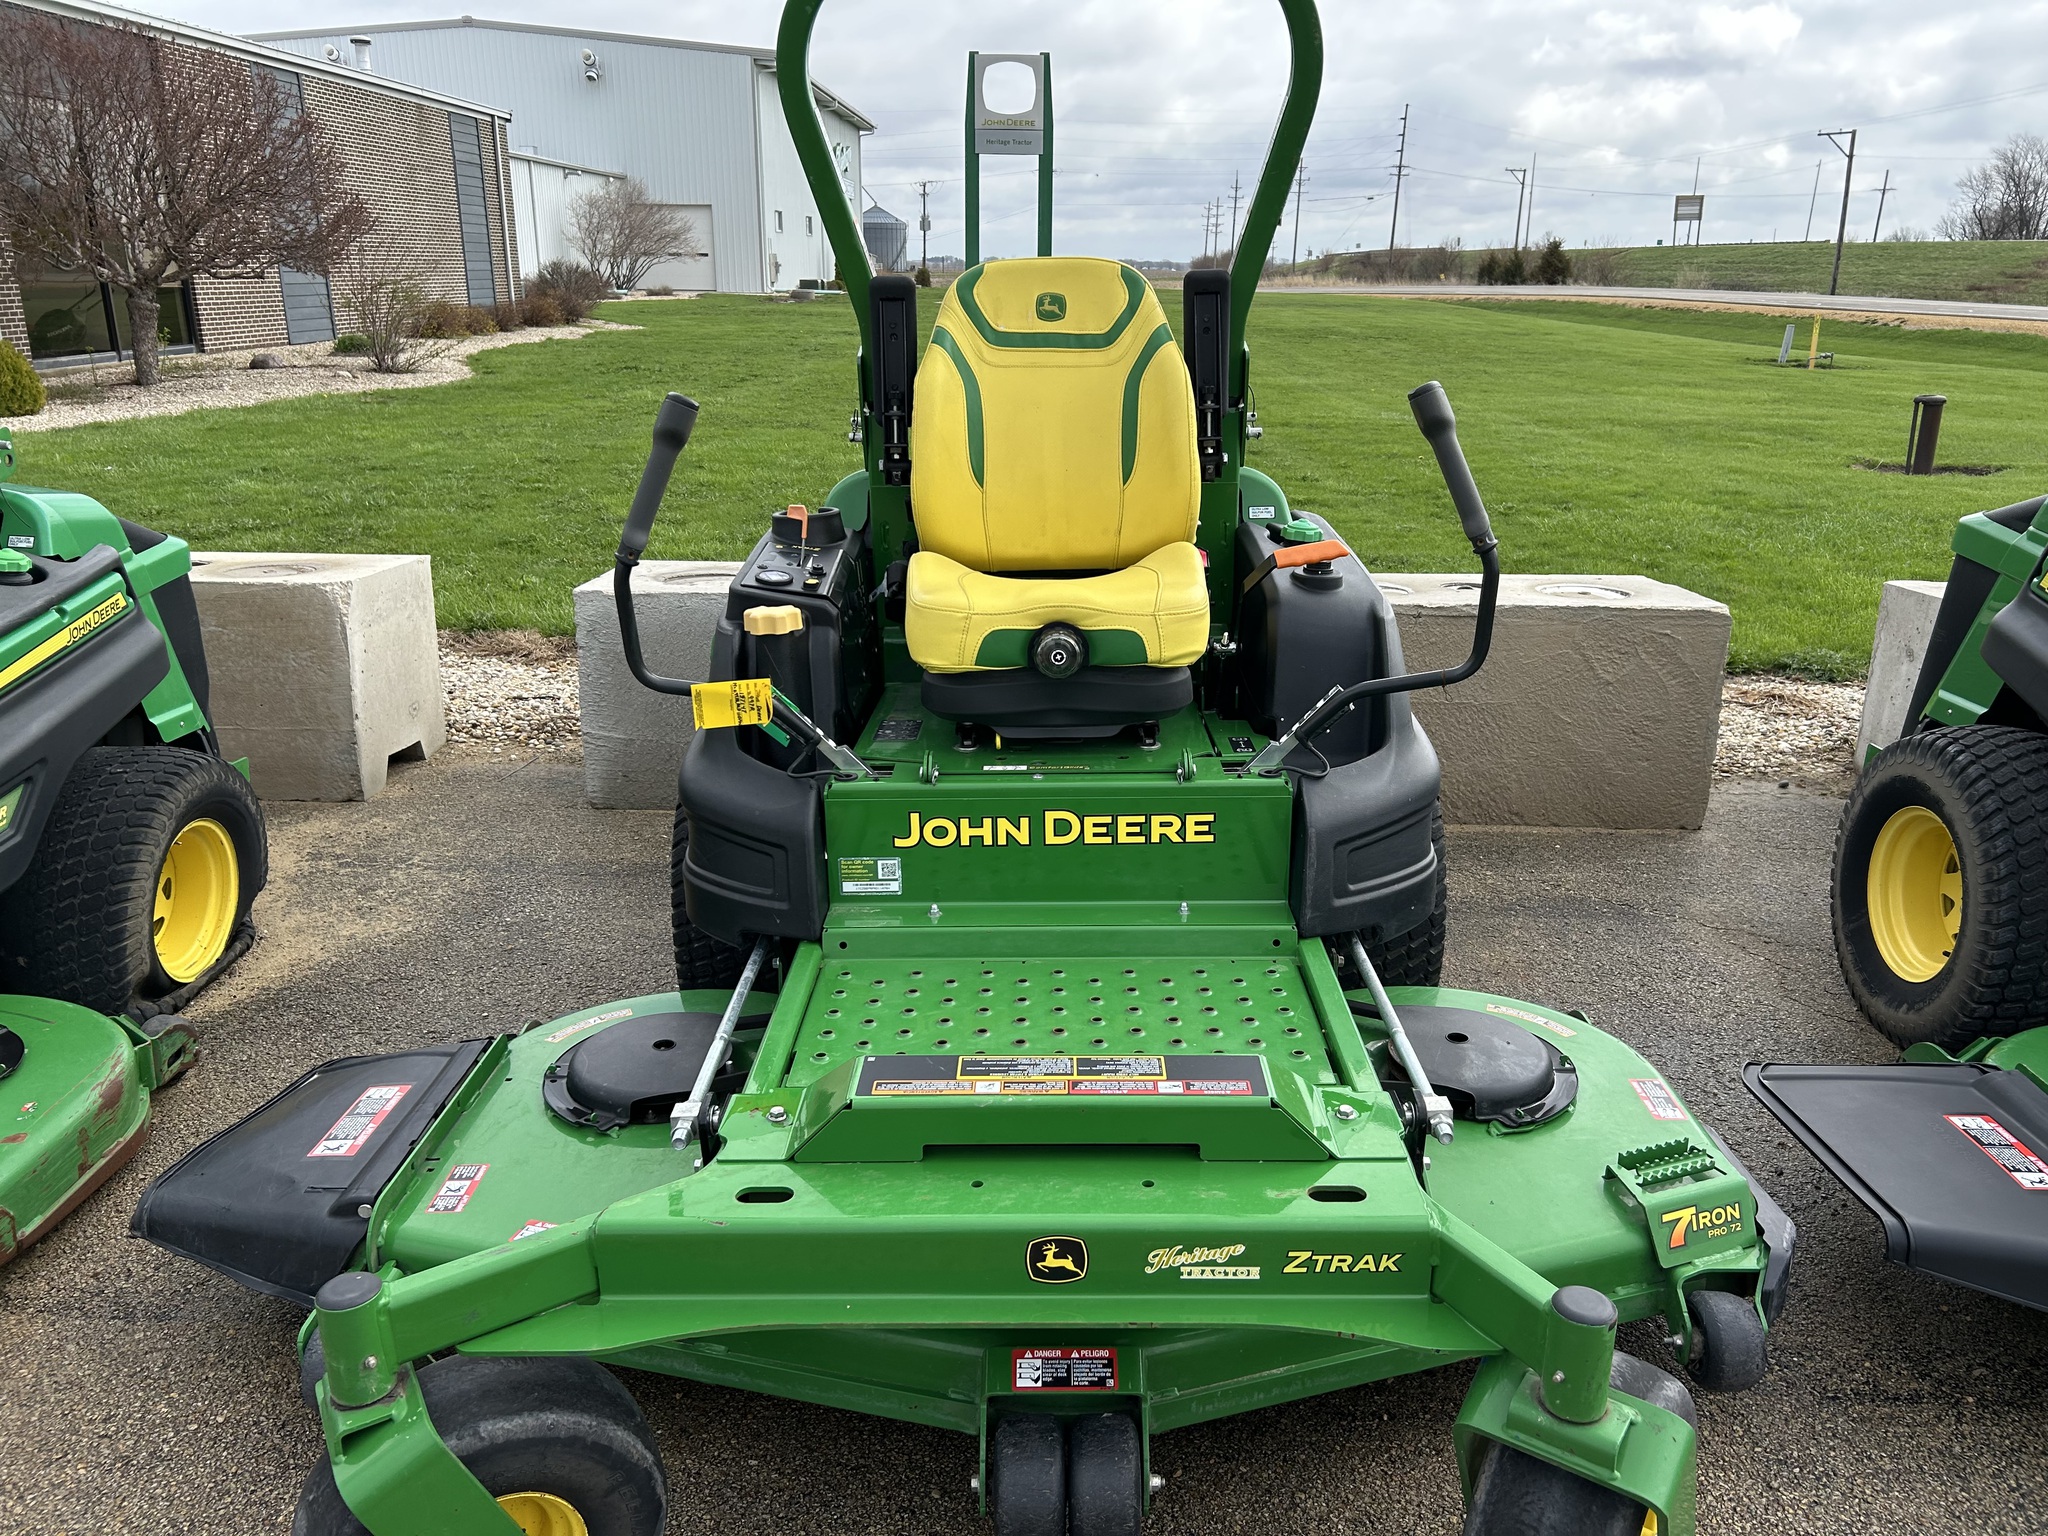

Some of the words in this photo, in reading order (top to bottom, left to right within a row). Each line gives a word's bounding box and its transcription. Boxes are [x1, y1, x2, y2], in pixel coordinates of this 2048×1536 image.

[981, 118, 1005, 127] JOHN
[1006, 118, 1036, 127] DEERE
[985, 138, 1011, 147] Heritage
[1012, 138, 1033, 147] Tractor
[67, 617, 92, 644] JOHN
[92, 598, 121, 626] DEERE
[892, 810, 1031, 849] JOHN
[1042, 809, 1217, 848] DEERE
[1708, 1226, 1728, 1239] PRO
[1729, 1222, 1742, 1233] 72
[1144, 1243, 1246, 1274] Heritage
[1281, 1249, 1406, 1275] ZTRAK
[1180, 1266, 1261, 1280] TRACTOR
[1034, 1349, 1062, 1358] DANGER
[1080, 1349, 1110, 1358] PELIGRO
